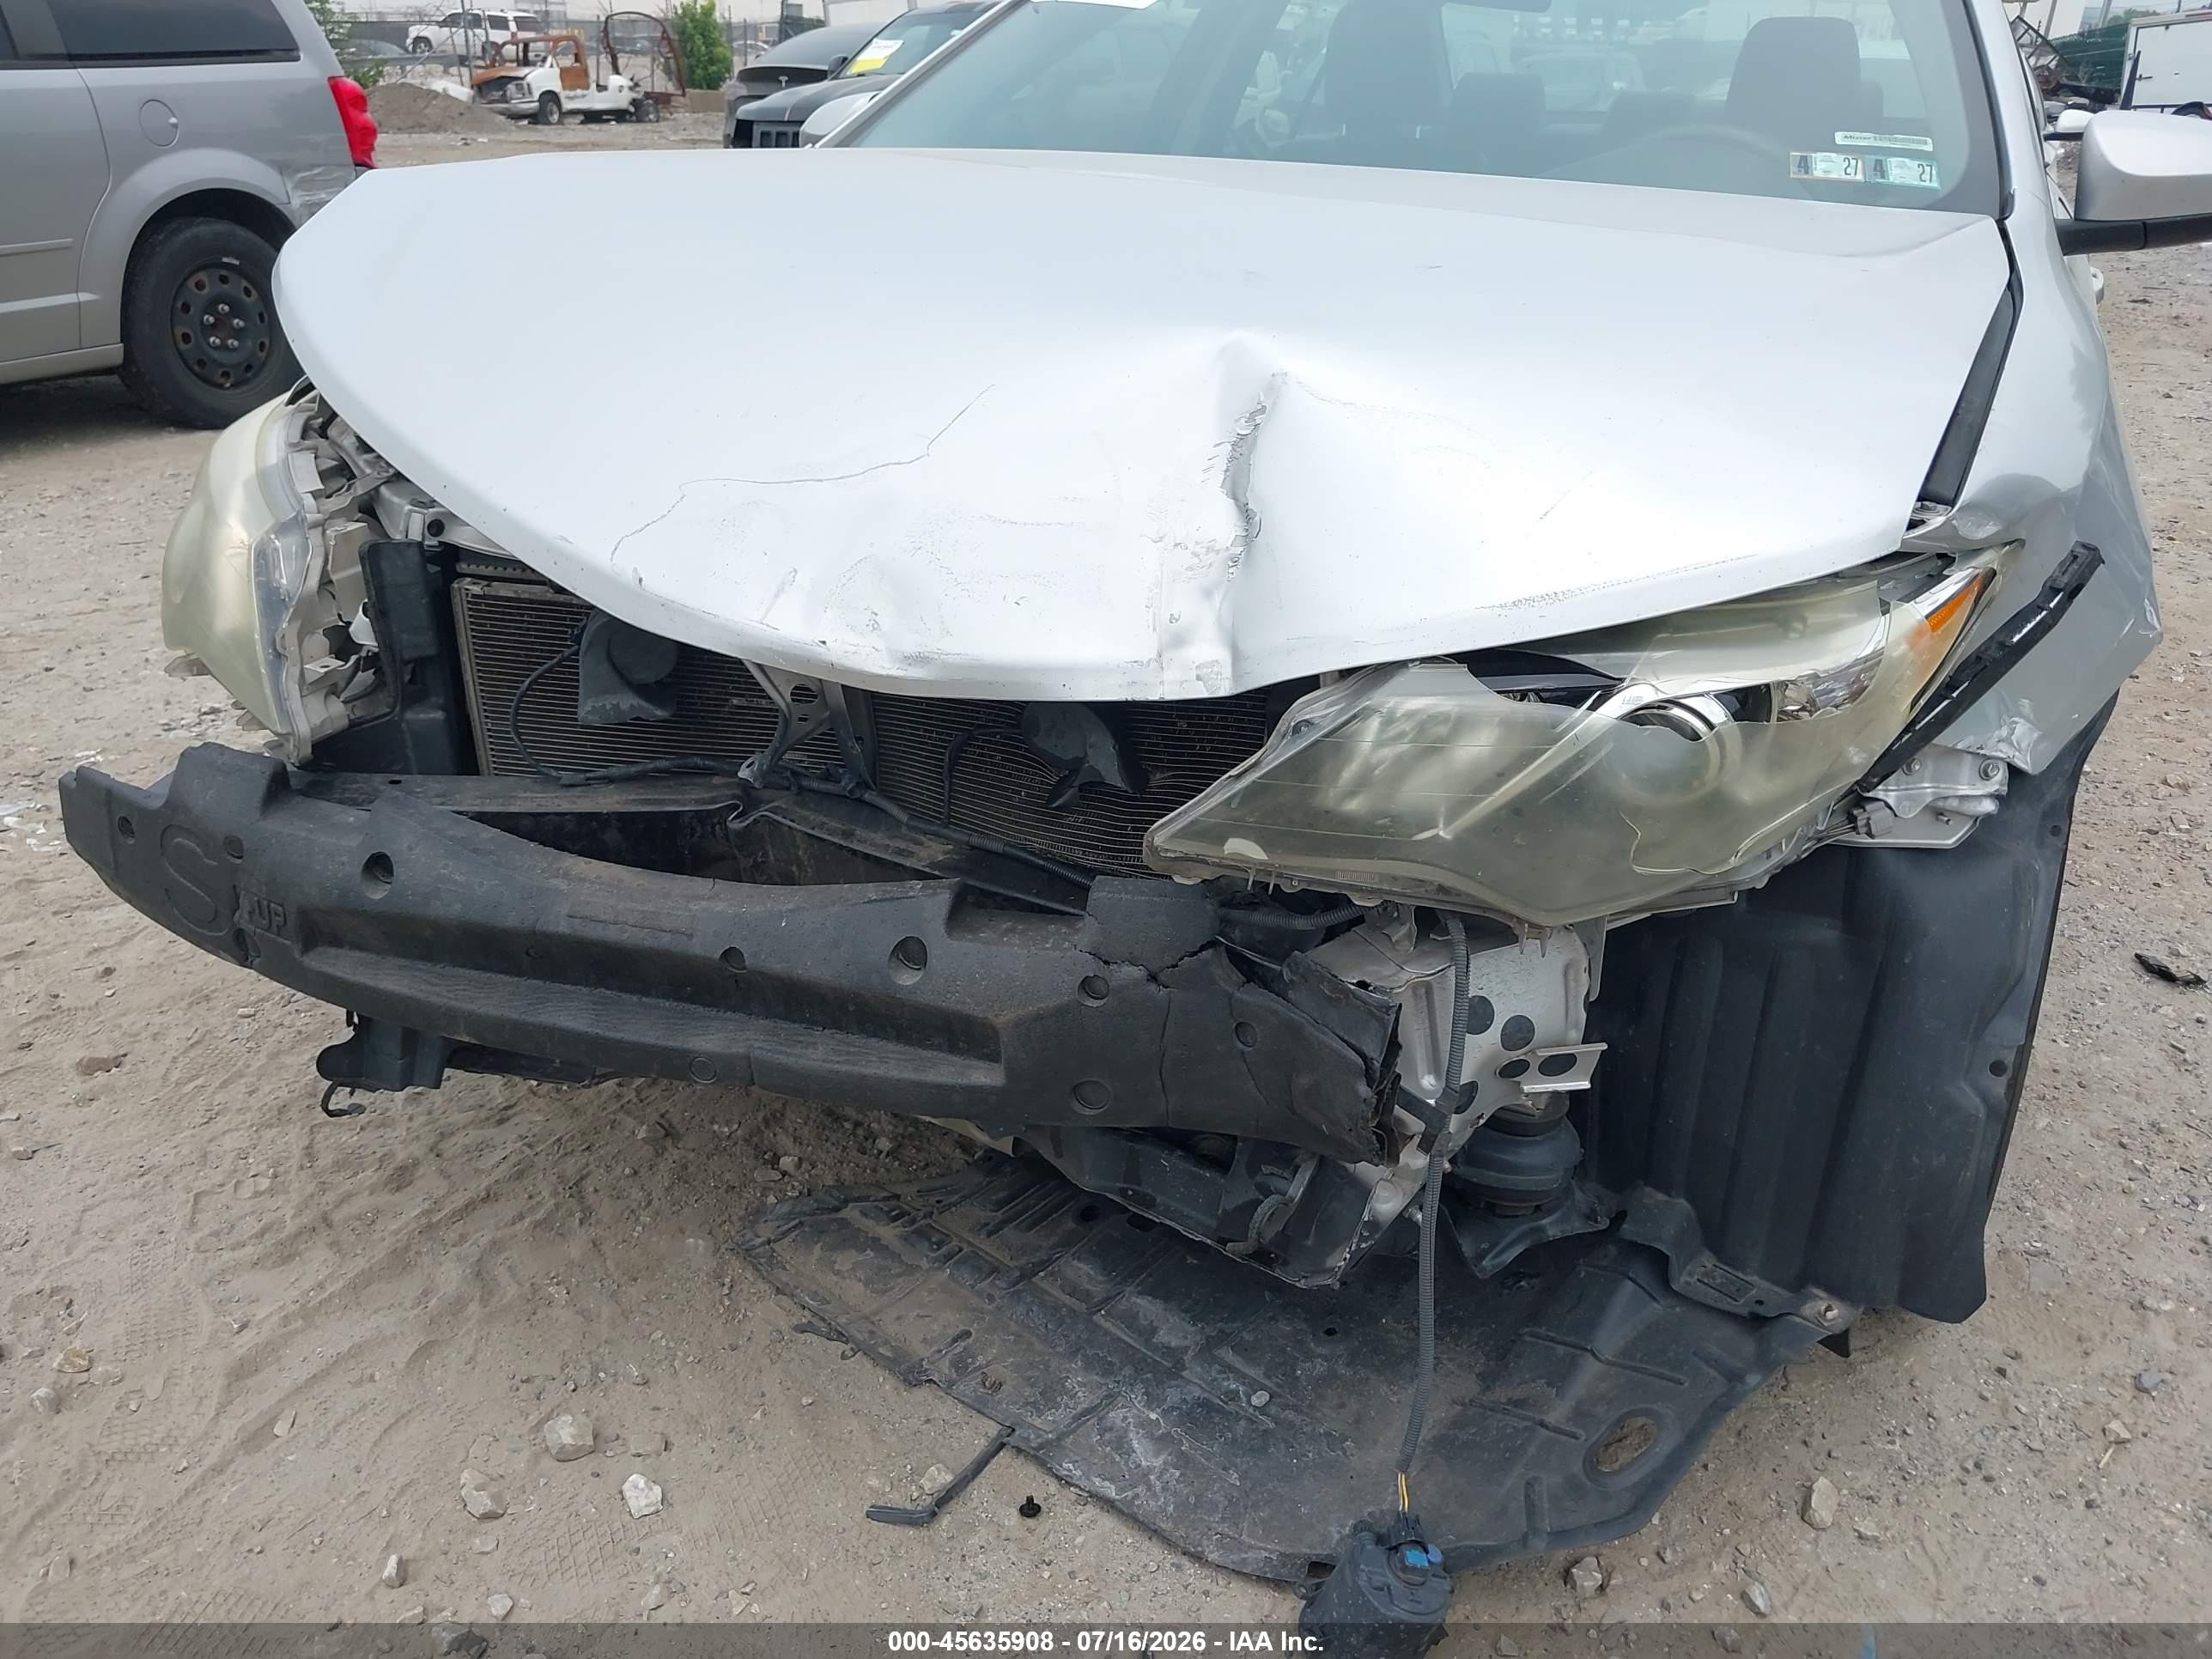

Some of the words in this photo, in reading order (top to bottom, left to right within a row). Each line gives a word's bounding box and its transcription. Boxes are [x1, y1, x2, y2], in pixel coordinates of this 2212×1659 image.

[1796, 155, 1809, 174] 4
[1843, 156, 1859, 177] 27
[1873, 159, 1886, 179] 4
[1917, 163, 1934, 184] 27
